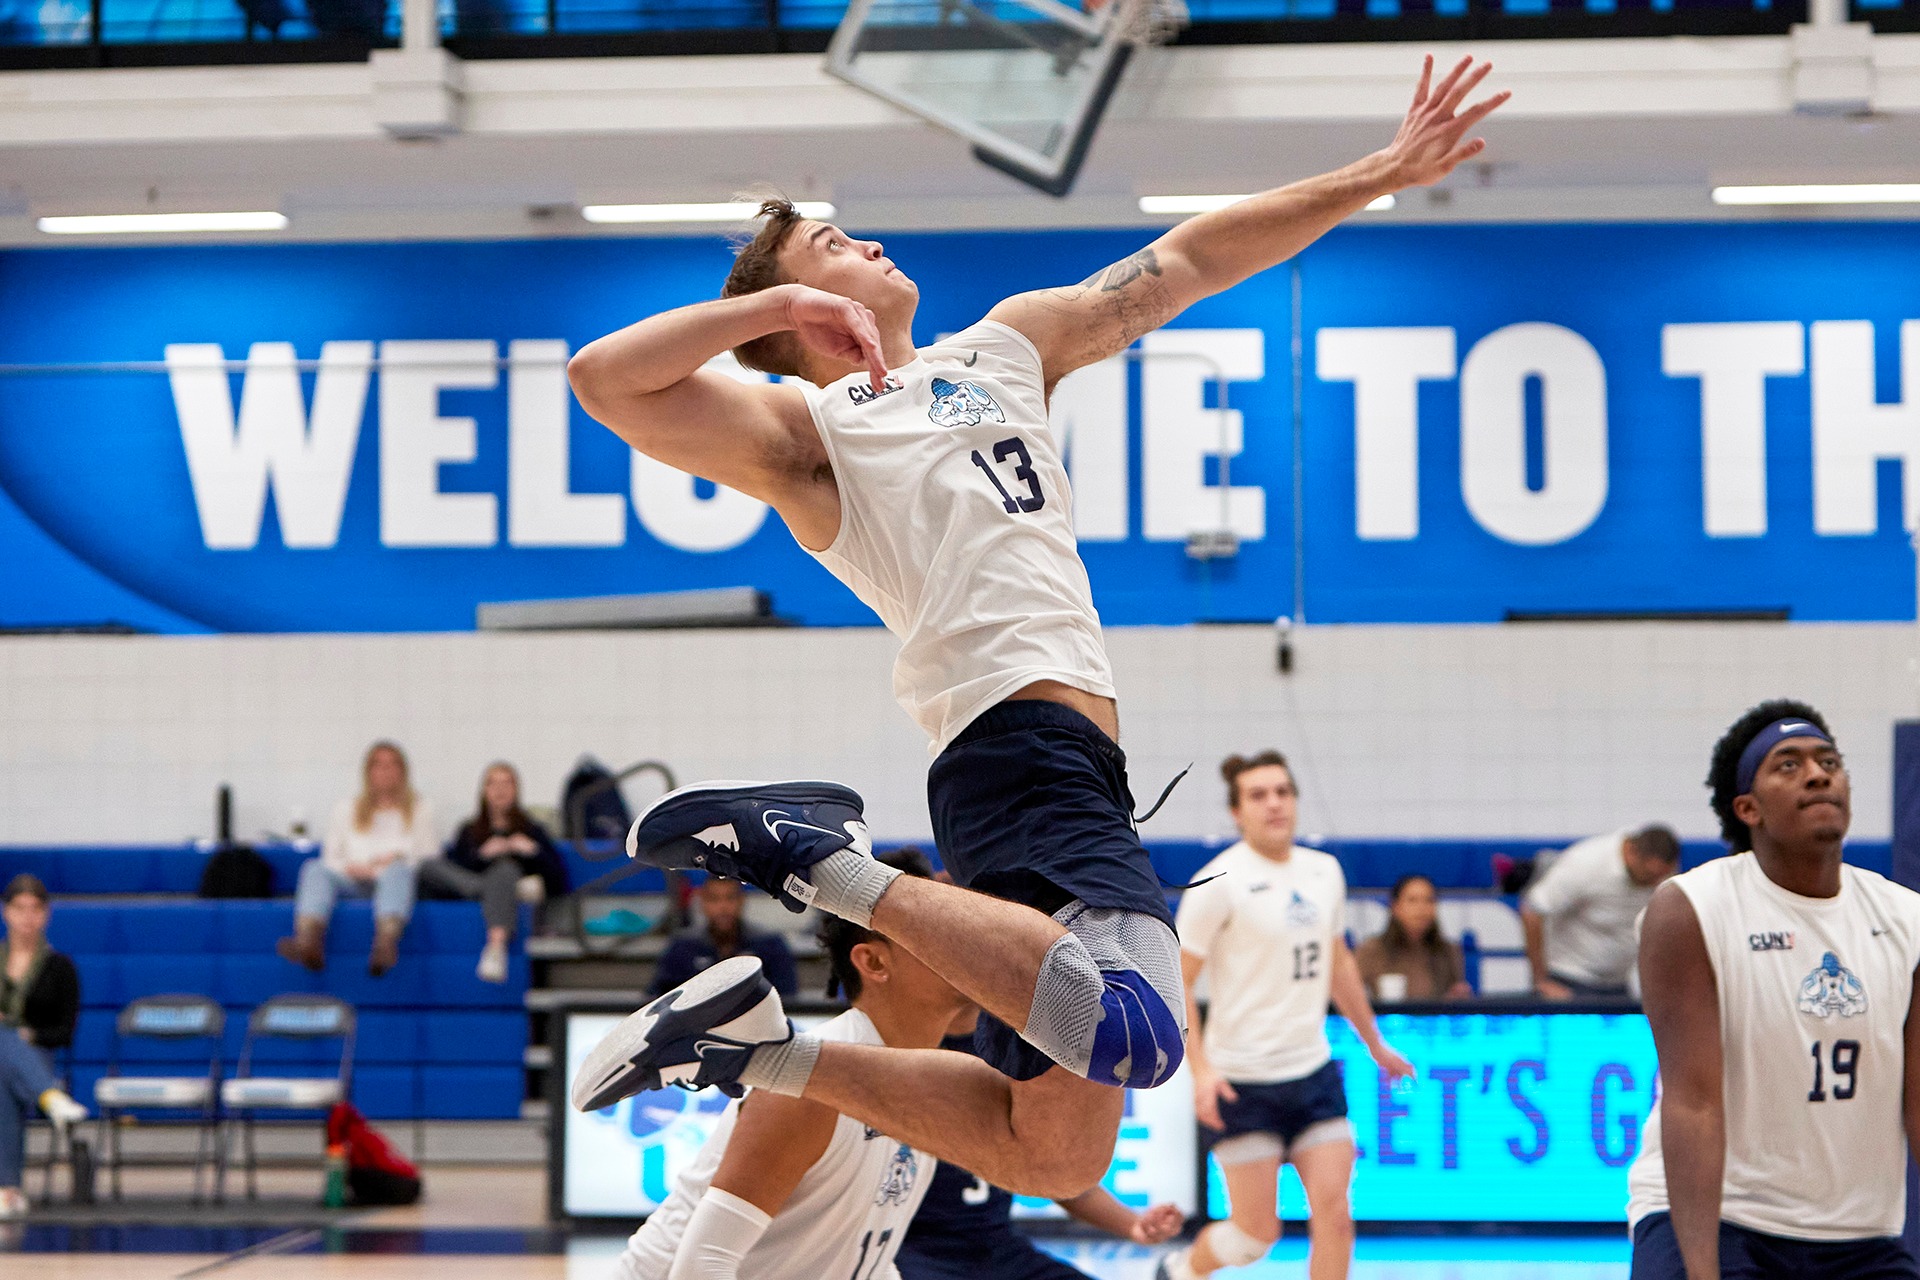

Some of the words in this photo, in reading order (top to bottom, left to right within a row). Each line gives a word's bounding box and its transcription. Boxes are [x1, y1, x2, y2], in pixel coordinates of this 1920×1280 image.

[1315, 321, 1608, 546] TO
[971, 436, 1046, 514] 13
[1292, 941, 1321, 981] 12
[1807, 1039, 1861, 1101] 19
[1338, 1060, 1549, 1169] ET'S
